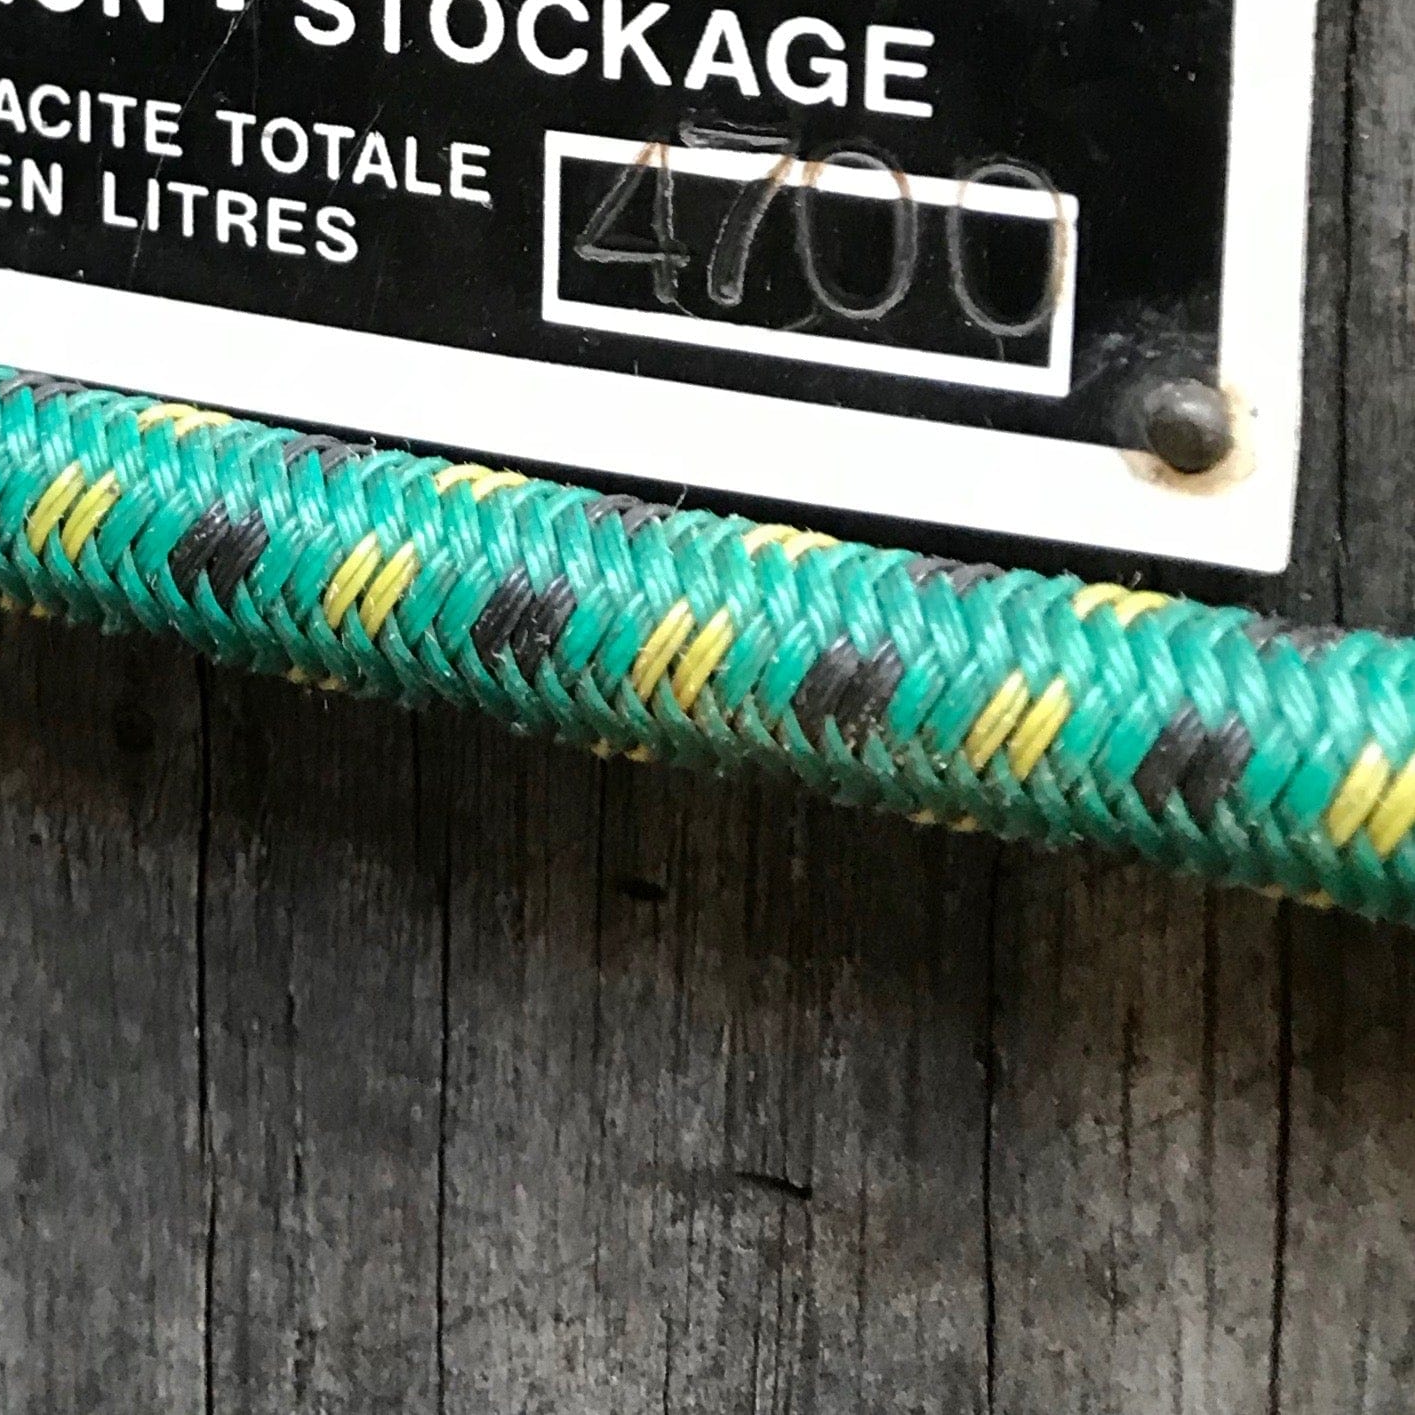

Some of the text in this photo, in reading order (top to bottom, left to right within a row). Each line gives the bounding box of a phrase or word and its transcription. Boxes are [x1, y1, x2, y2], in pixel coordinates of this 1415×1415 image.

[214, 108, 492, 208] TOTALE
[101, 171, 360, 265] LITRES
[574, 121, 1072, 338] 4700
